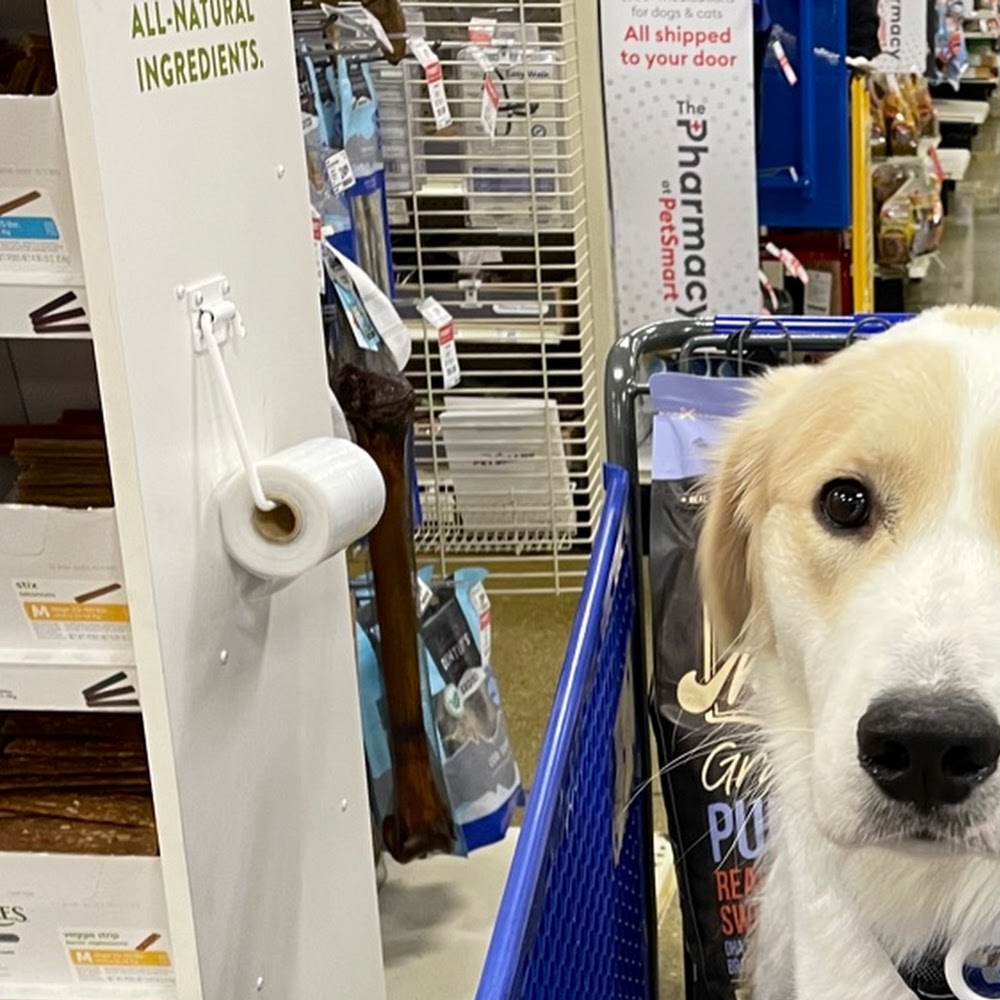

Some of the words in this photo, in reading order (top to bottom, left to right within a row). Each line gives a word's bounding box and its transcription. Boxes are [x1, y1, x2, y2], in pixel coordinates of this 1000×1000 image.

[132, 0, 255, 38] ALL-NATURAL
[631, 7, 648, 18] for
[651, 7, 681, 20] dogs
[684, 7, 693, 18] &
[696, 8, 724, 19] cats
[624, 25, 650, 42] All
[655, 26, 732, 47] shipped
[136, 39, 264, 92] INGREDIENTS.
[620, 51, 640, 65] to
[645, 53, 688, 69] your
[692, 50, 737, 66] door
[676, 100, 706, 115] The
[662, 180, 671, 194] at
[676, 119, 708, 318] Pharmacy
[658, 198, 679, 301] PetSmart
[31, 604, 51, 618] M
[76, 952, 93, 963] M
